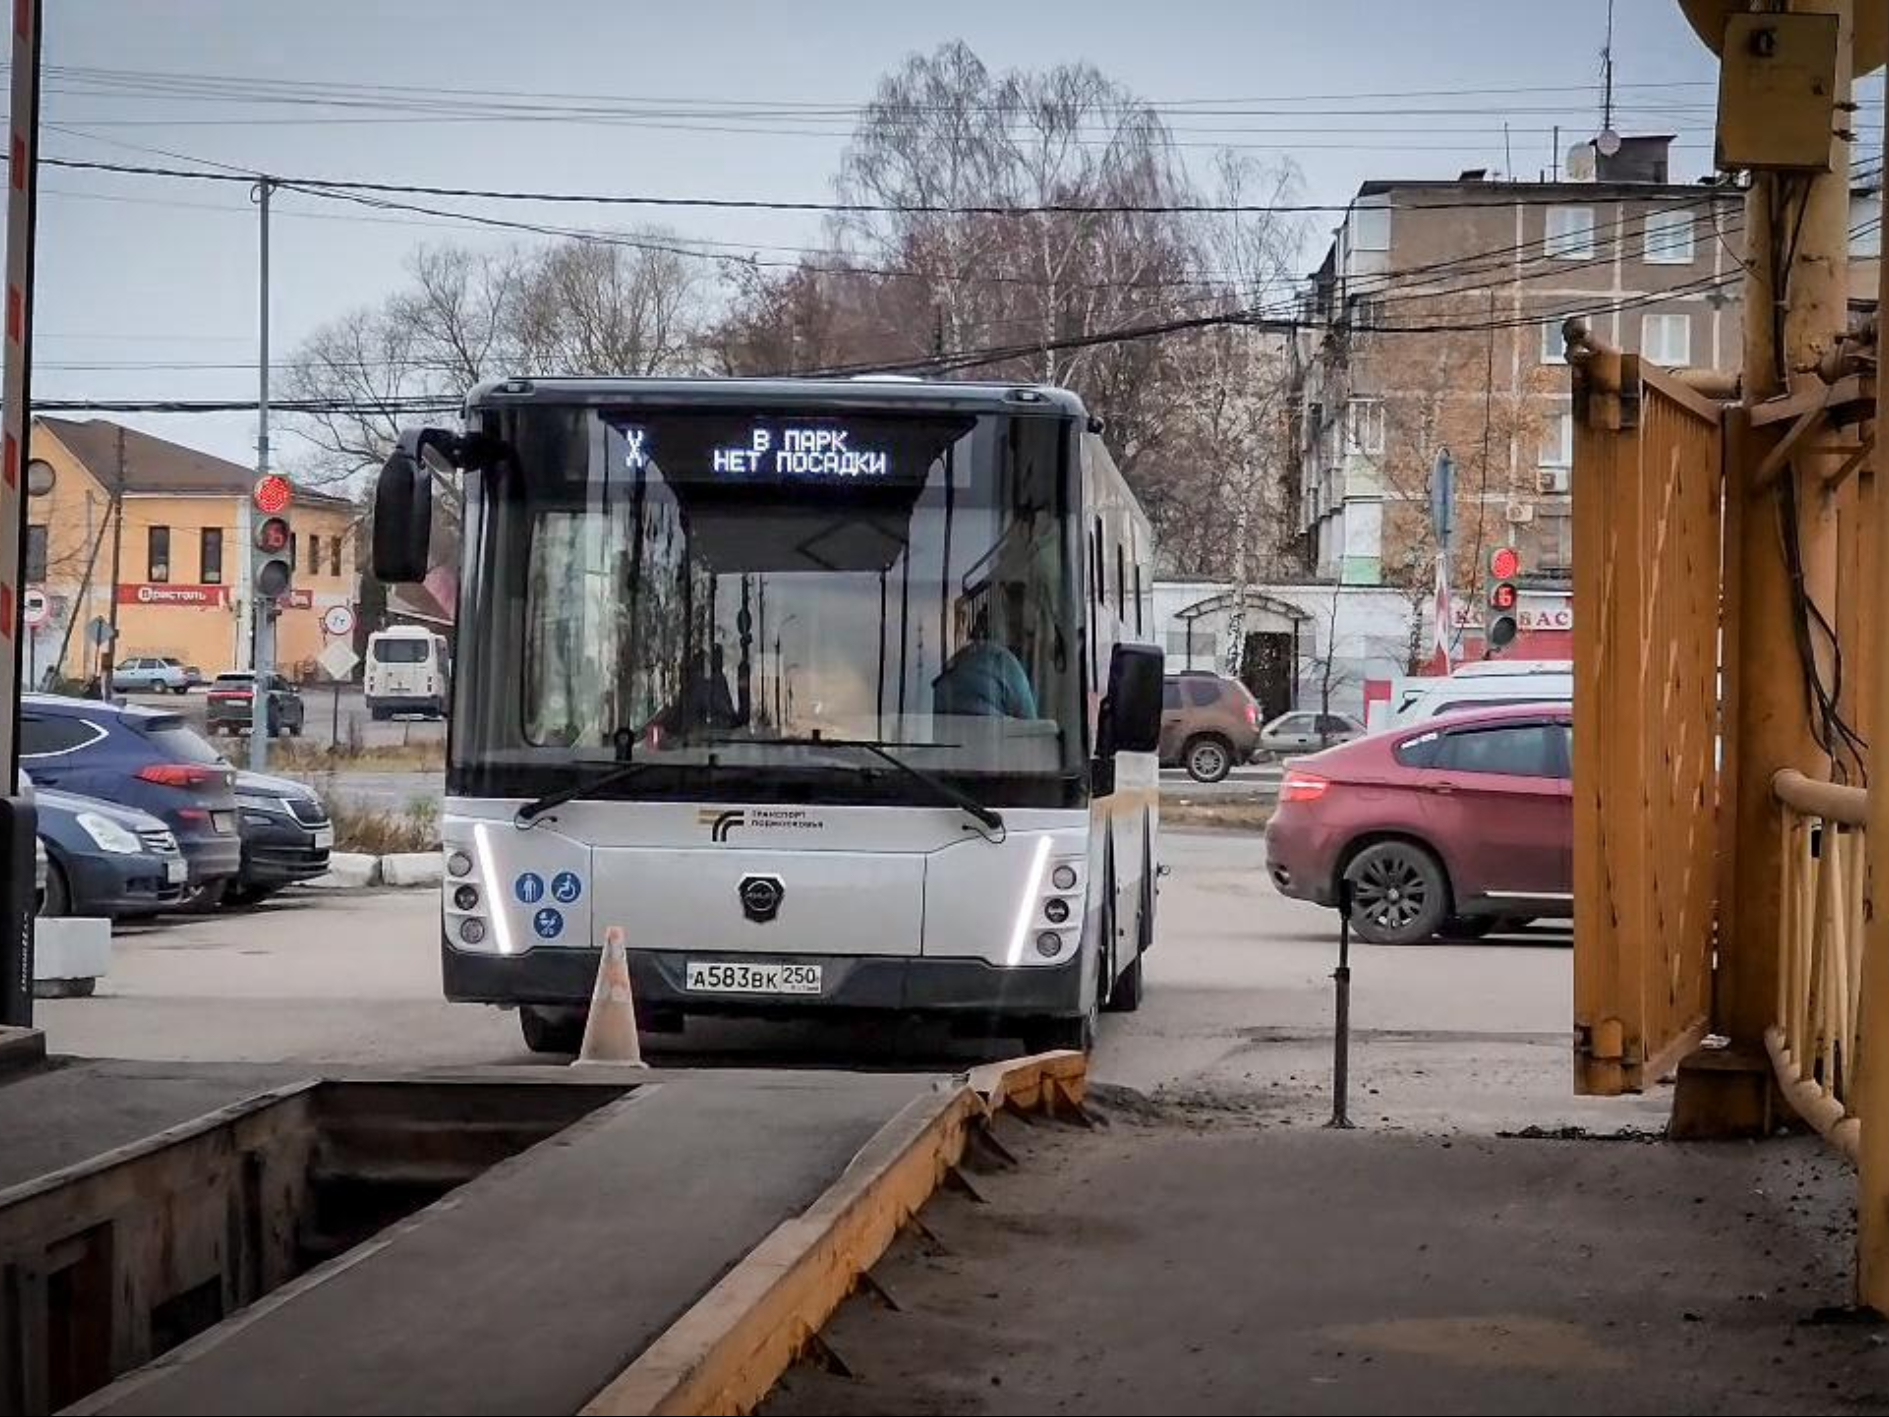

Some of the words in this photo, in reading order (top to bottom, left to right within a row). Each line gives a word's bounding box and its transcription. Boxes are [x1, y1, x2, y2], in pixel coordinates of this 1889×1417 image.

[753, 429, 770, 452] В
[784, 429, 849, 452] ПАРК
[713, 449, 761, 473] НЕТ
[776, 450, 887, 477] ПОСАДКИ
[693, 966, 778, 990] А583ВК
[783, 967, 816, 984] 250
